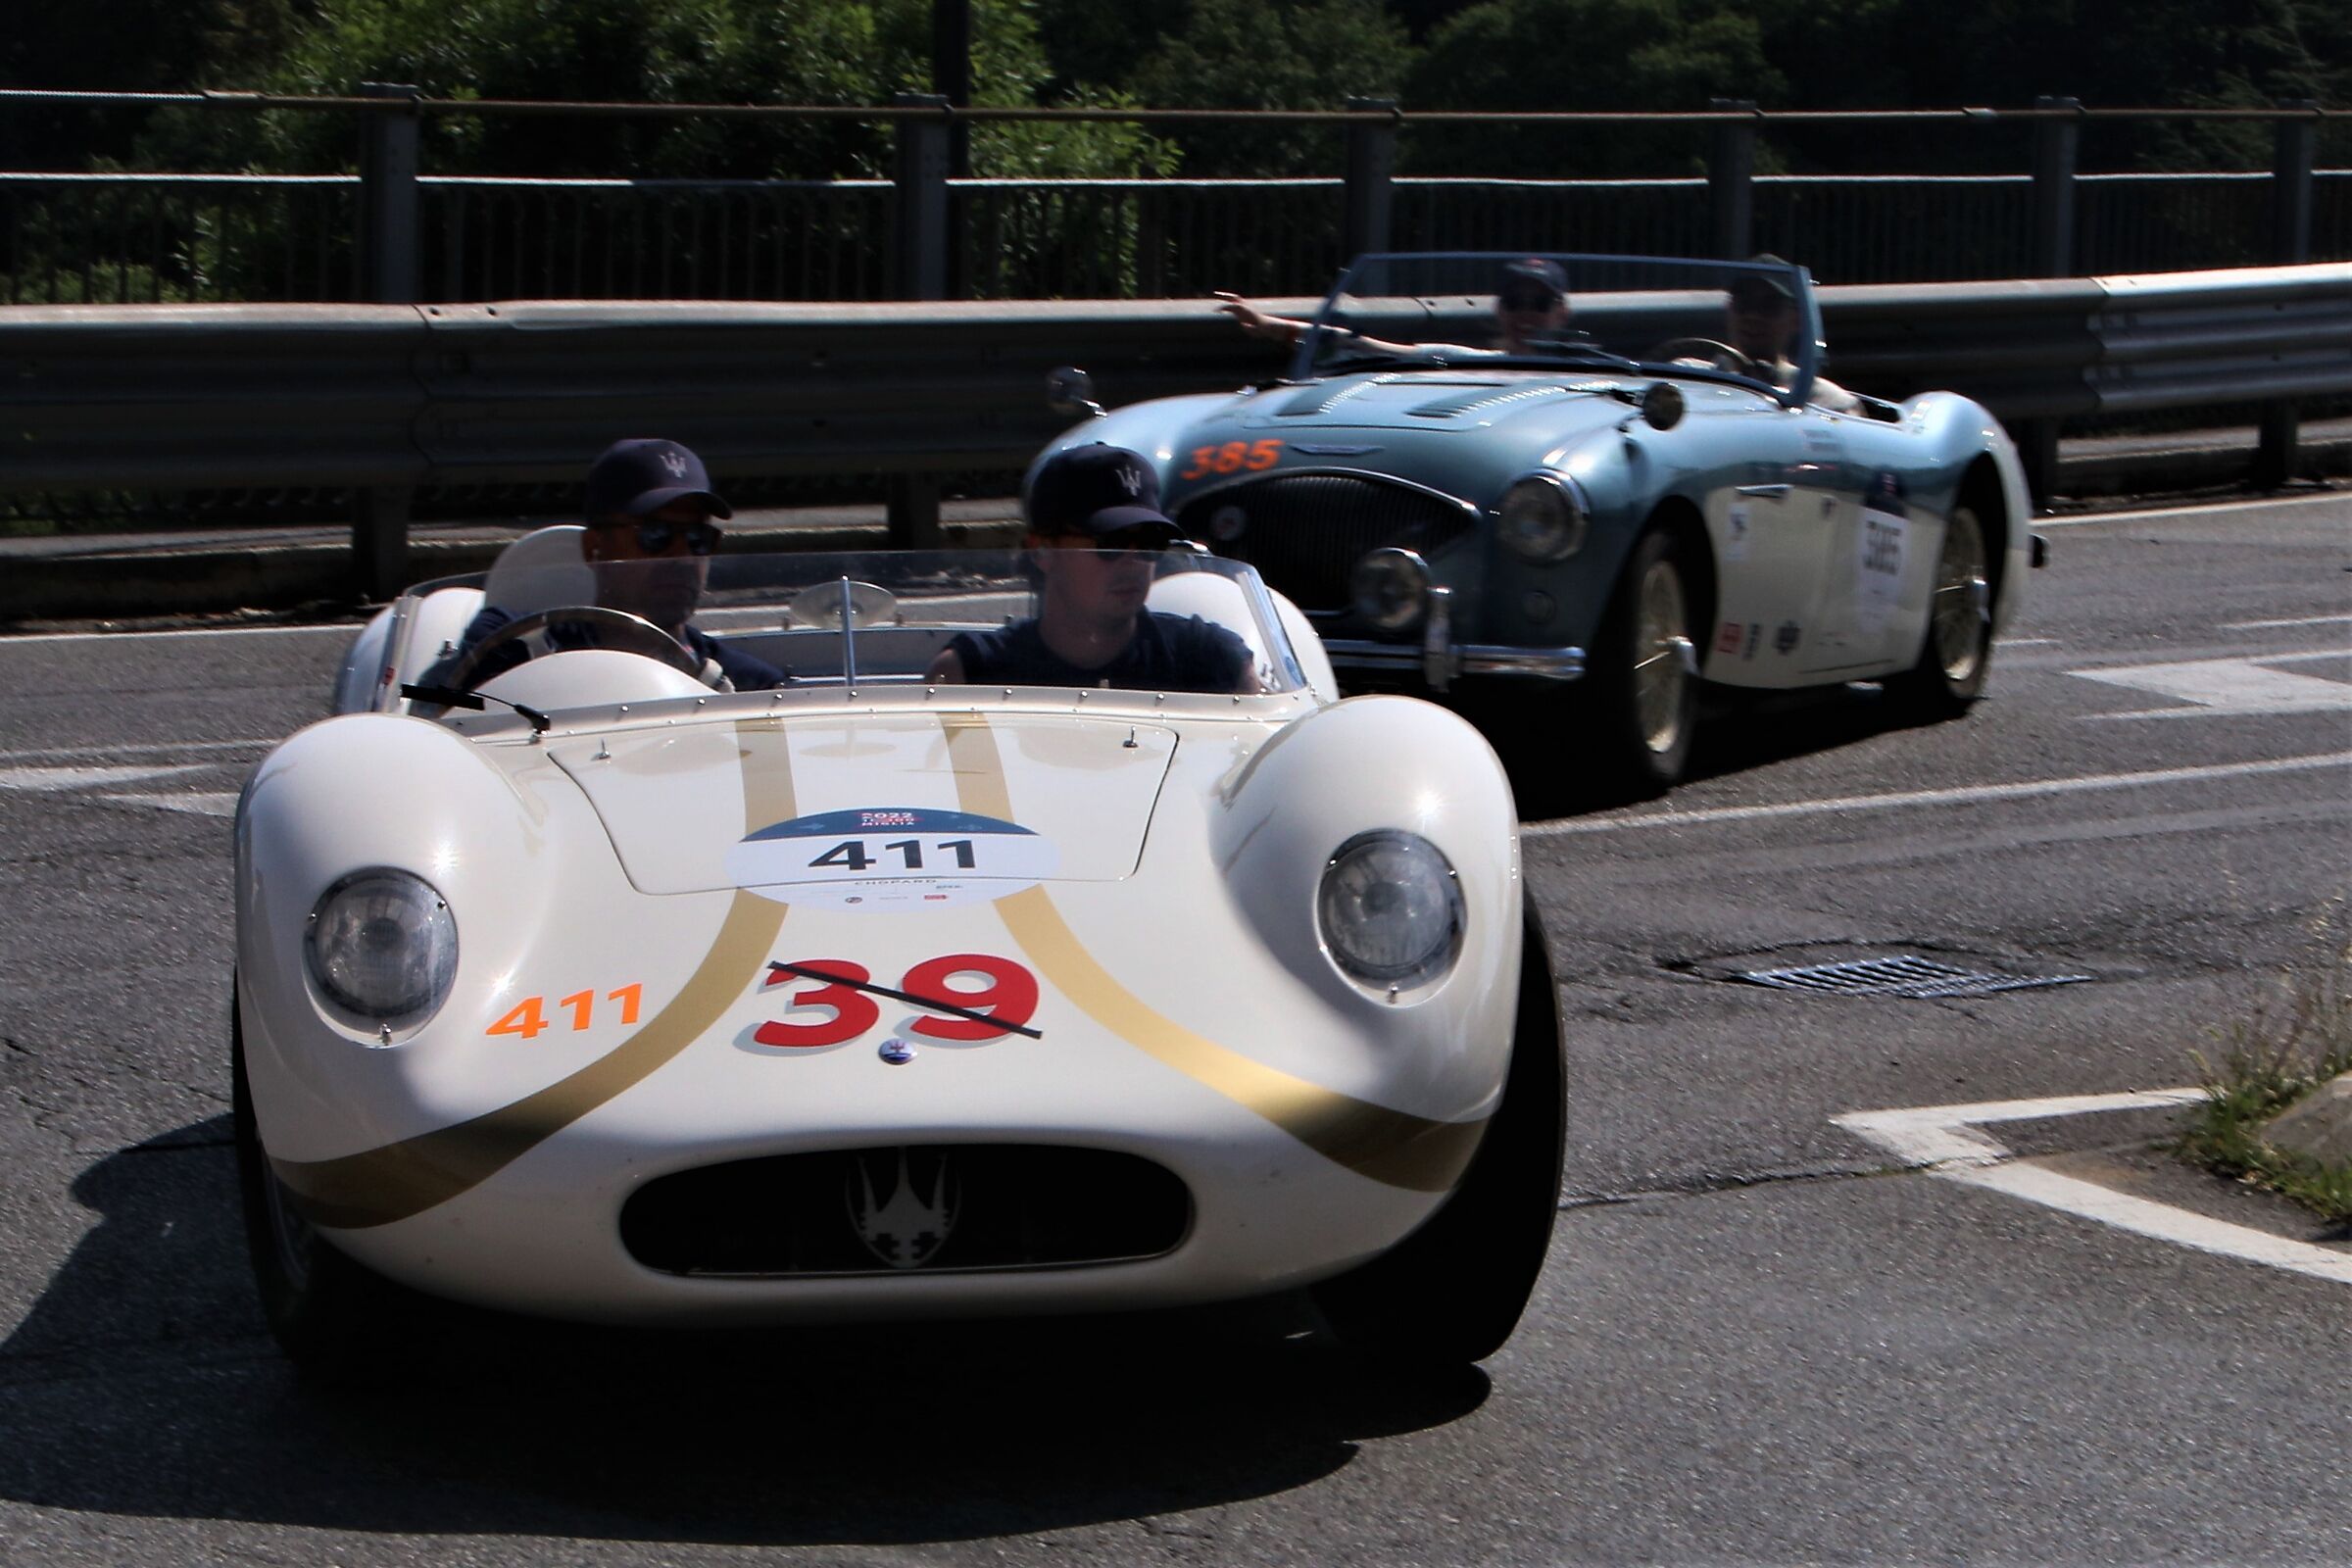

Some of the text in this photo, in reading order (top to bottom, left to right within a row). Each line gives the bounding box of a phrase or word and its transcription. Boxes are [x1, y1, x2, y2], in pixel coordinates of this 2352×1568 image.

[1182, 439, 1283, 479] 385
[808, 840, 976, 870] 411
[486, 983, 642, 1039] 411
[755, 954, 1039, 1047] 39
